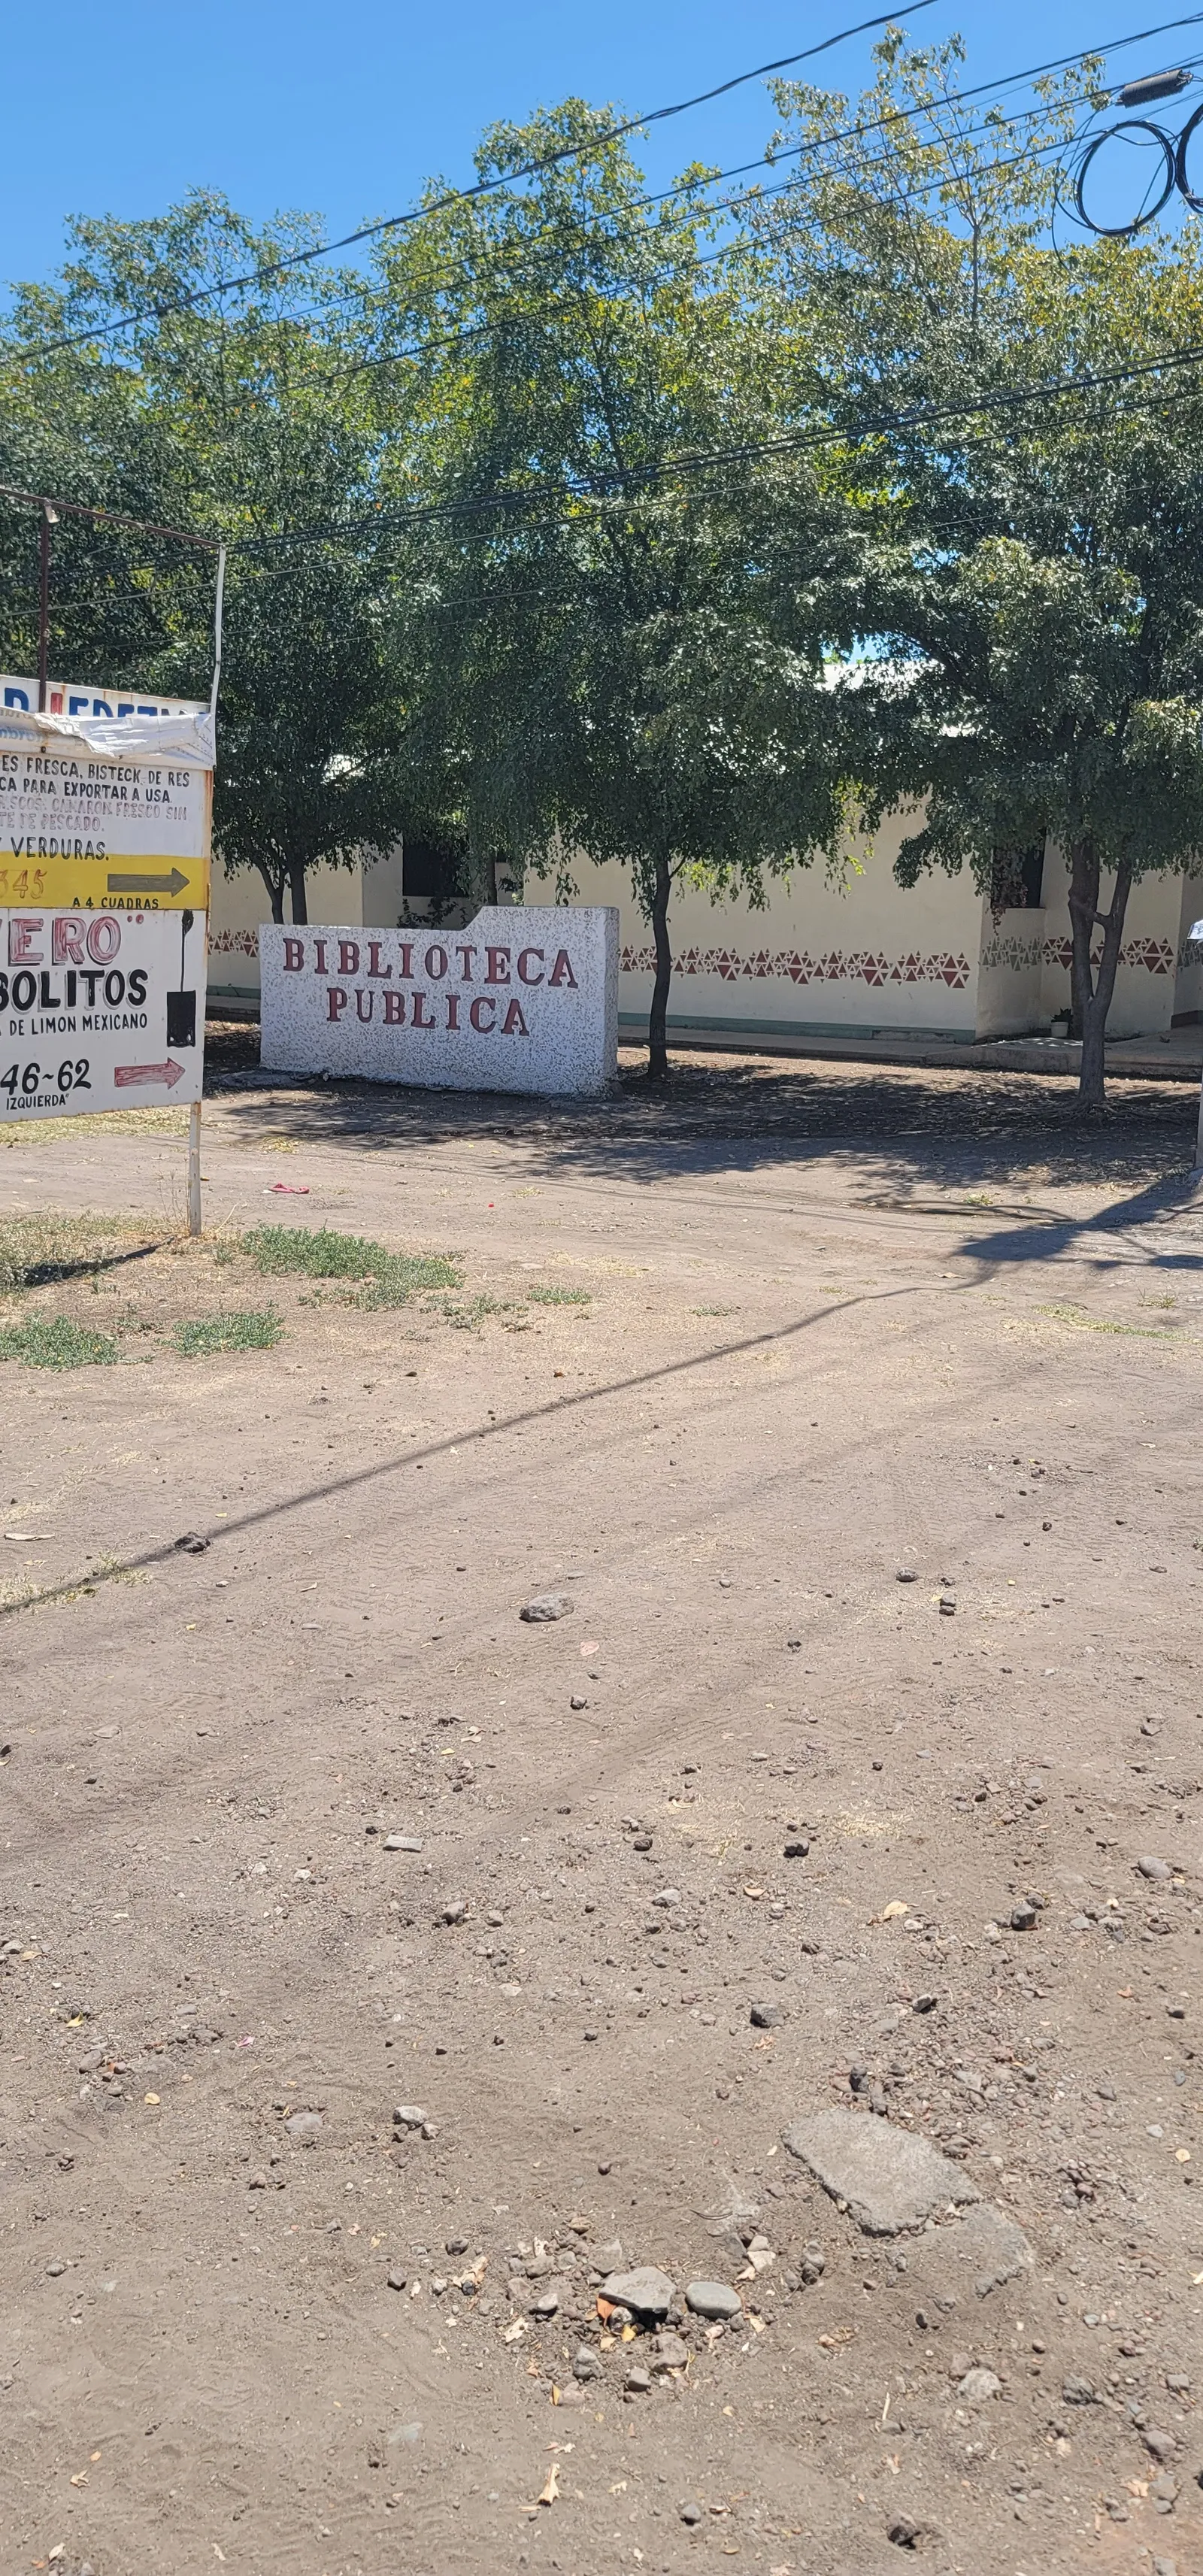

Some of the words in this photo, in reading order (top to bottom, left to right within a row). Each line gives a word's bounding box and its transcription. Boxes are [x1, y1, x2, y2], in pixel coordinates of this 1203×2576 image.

[2, 754, 18, 772] ES
[149, 771, 162, 785] DE
[168, 771, 189, 787] RES
[23, 778, 56, 795] PARA
[64, 781, 127, 801] EXPORTAR
[132, 788, 140, 801] A
[116, 802, 160, 819] FRESCO
[166, 806, 186, 820] SIN
[41, 814, 105, 832] PESCADO.
[11, 837, 109, 861] VERDURAS.
[73, 897, 81, 908] A
[86, 896, 94, 908] 4
[102, 896, 159, 909] CUADRAS
[283, 938, 579, 989] BIBLIOTECA
[326, 987, 530, 1037] PUBLICA
[10, 1020, 25, 1036] DE
[32, 1016, 76, 1035] LIMON
[83, 1013, 148, 1031] MEXICANO
